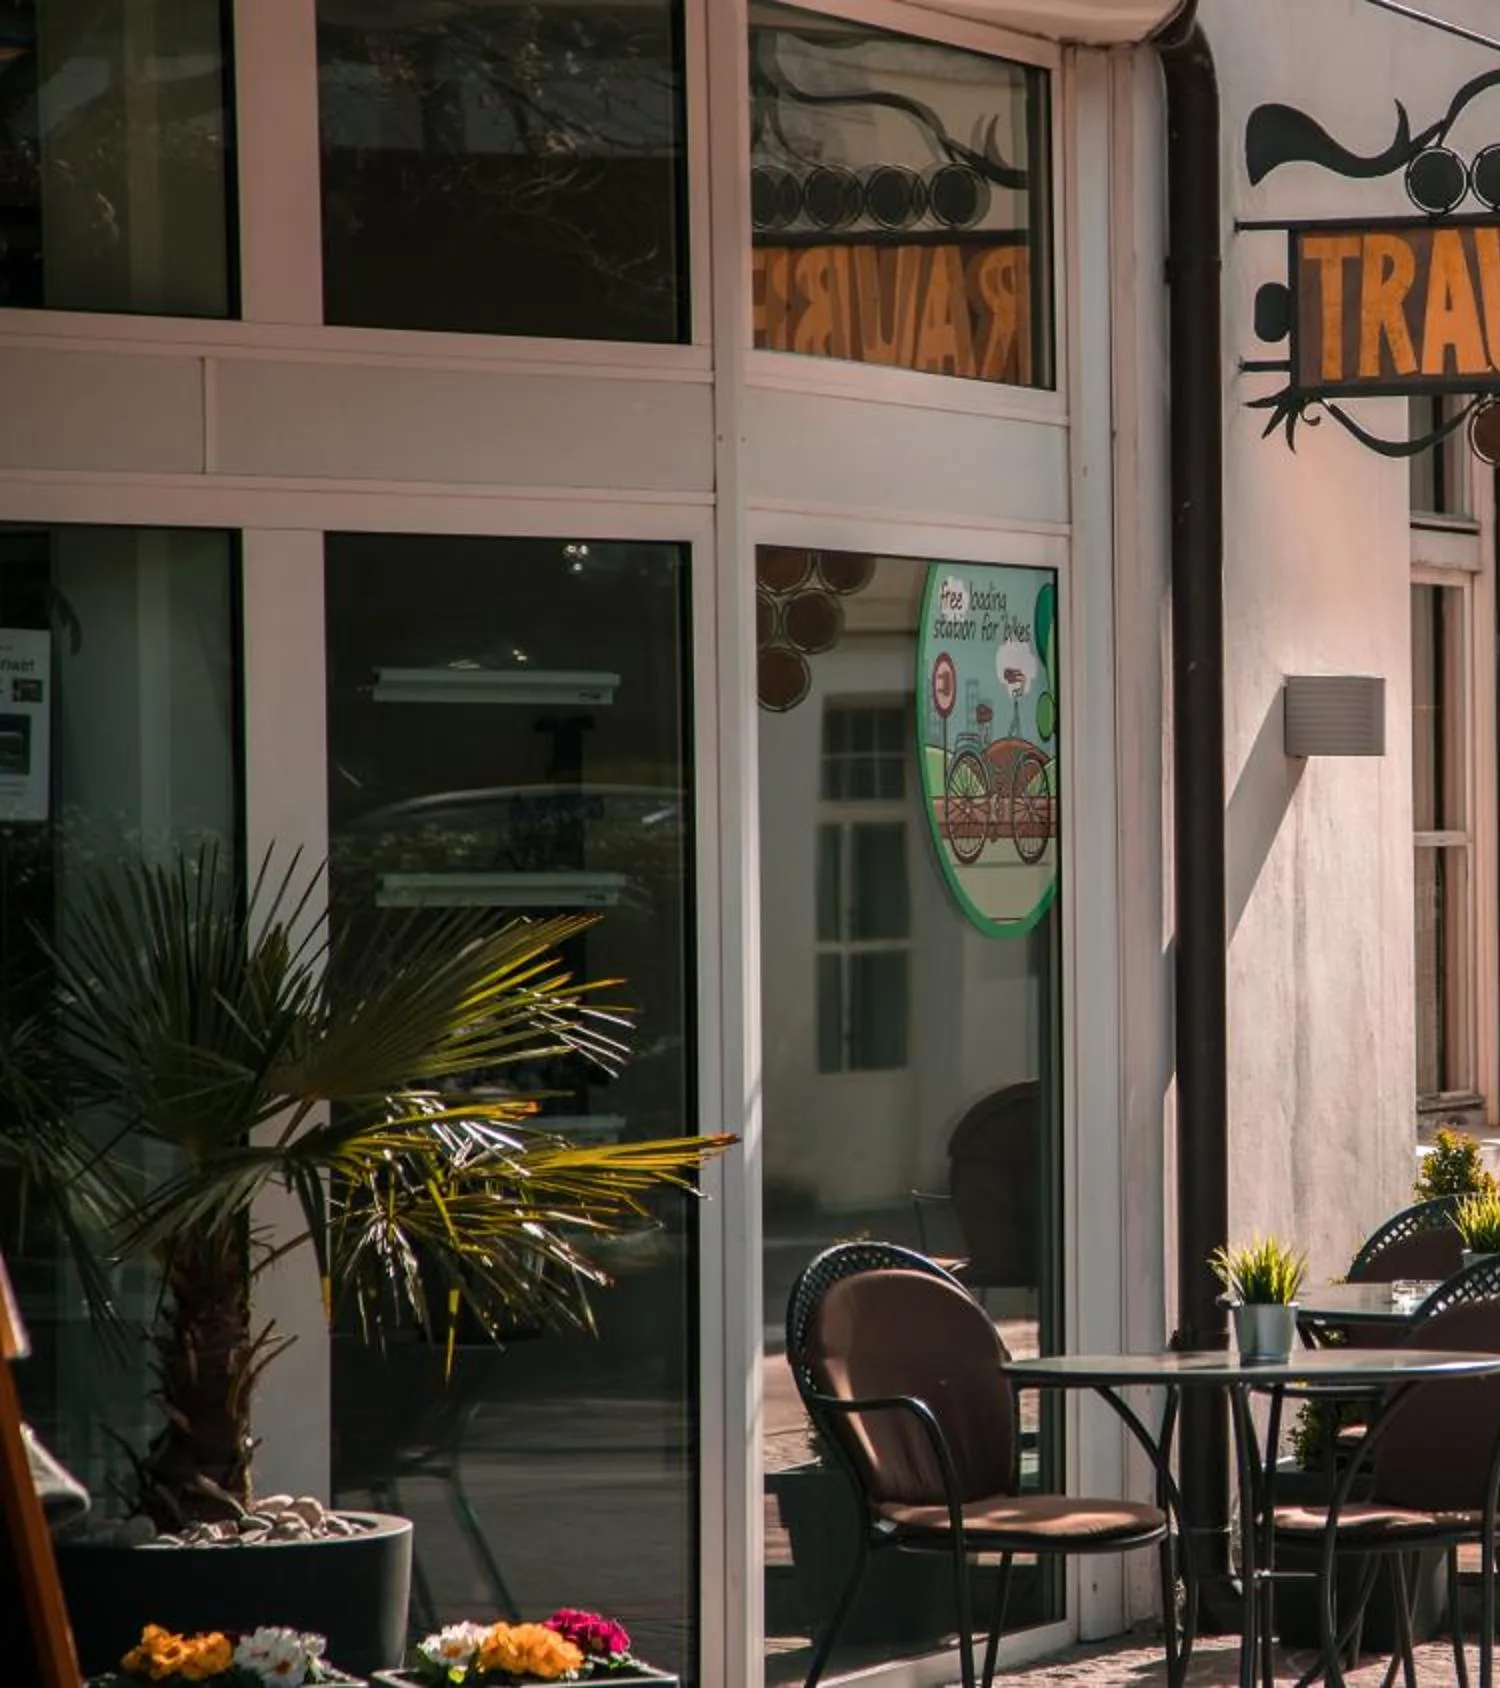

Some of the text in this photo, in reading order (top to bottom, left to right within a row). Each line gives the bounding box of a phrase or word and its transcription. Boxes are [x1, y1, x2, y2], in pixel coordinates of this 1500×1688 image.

[940, 579, 1007, 611] free loading
[933, 612, 1031, 643] station for bikes
